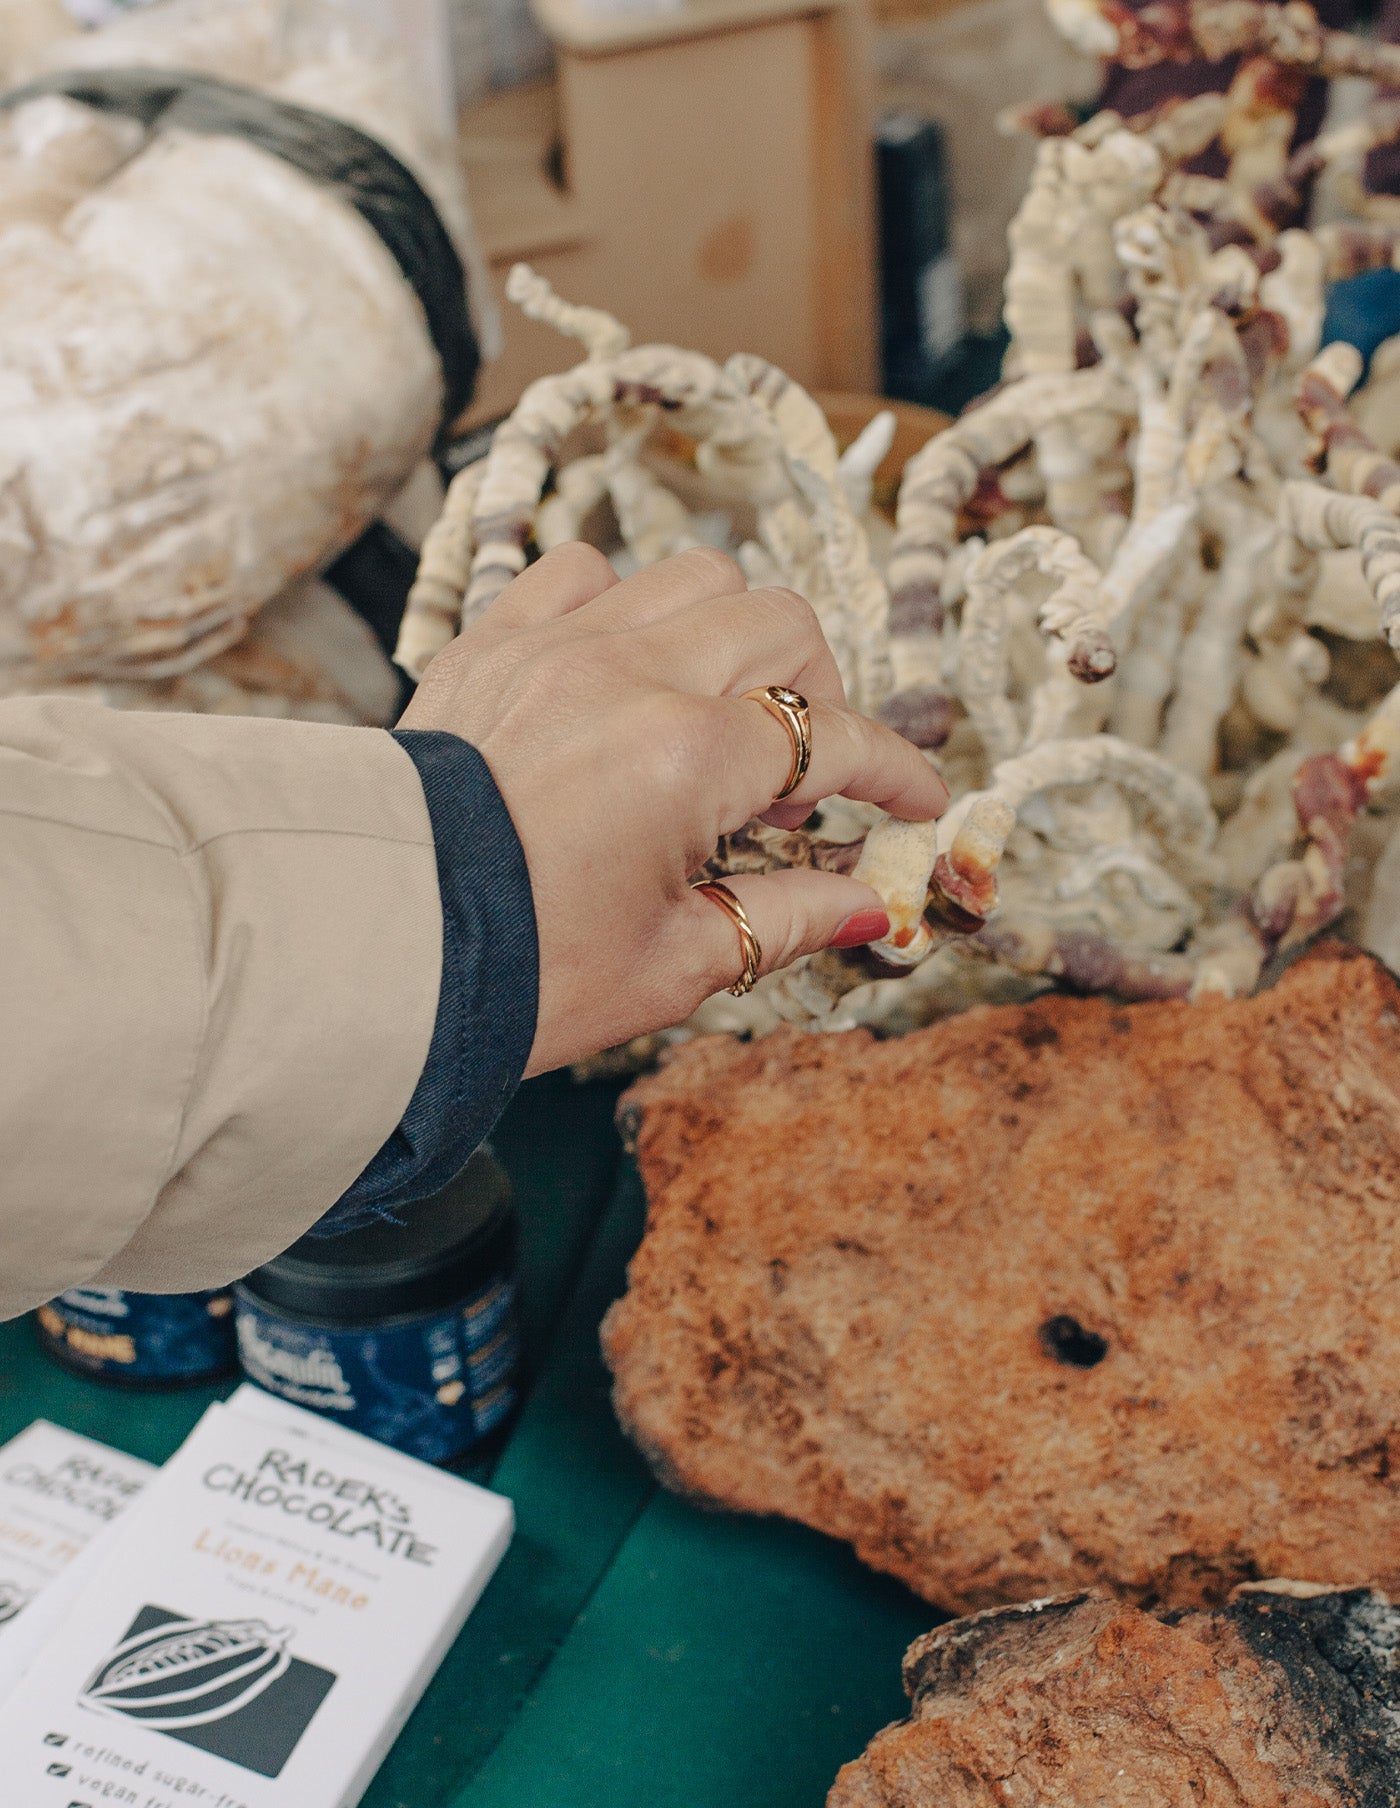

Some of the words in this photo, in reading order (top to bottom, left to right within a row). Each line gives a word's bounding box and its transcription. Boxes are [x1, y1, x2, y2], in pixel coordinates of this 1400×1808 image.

[202, 1462, 438, 1567] CHOCOLATE
[193, 1527, 278, 1575] Lions
[287, 1561, 370, 1611] Mane
[73, 1741, 150, 1776] refined
[78, 1774, 139, 1805] vegan
